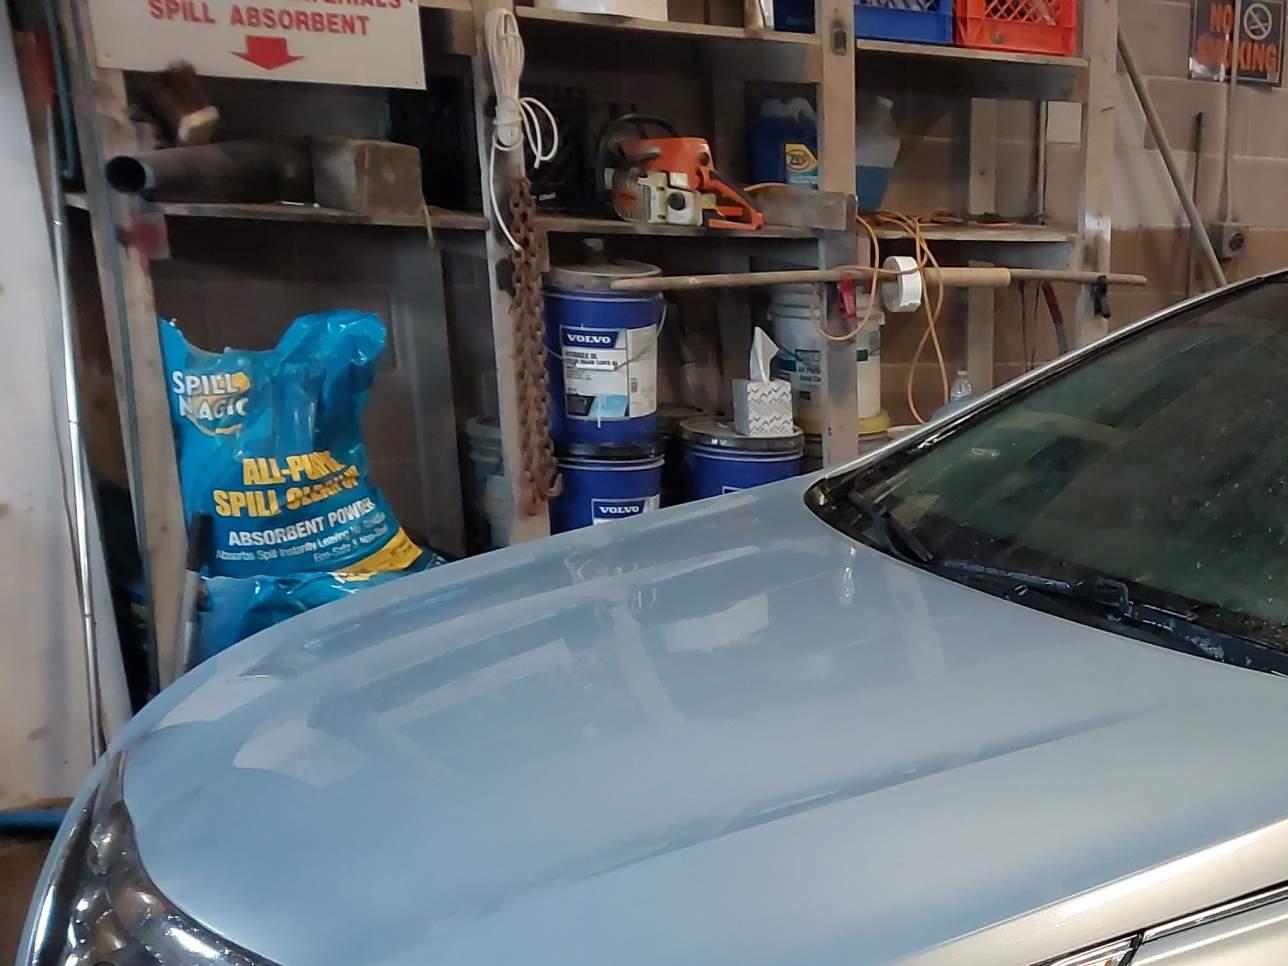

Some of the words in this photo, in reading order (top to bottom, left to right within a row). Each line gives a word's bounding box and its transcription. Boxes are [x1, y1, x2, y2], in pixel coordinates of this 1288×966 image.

[149, 0, 216, 24] SPILL
[230, 5, 371, 35] ABSORBENT
[1210, 3, 1233, 33] NO
[567, 333, 612, 344] VOLVO
[172, 370, 240, 396] SPILL
[213, 489, 281, 518] SPILL
[598, 505, 640, 514] VOLVO
[229, 516, 325, 547] ABSORBENT
